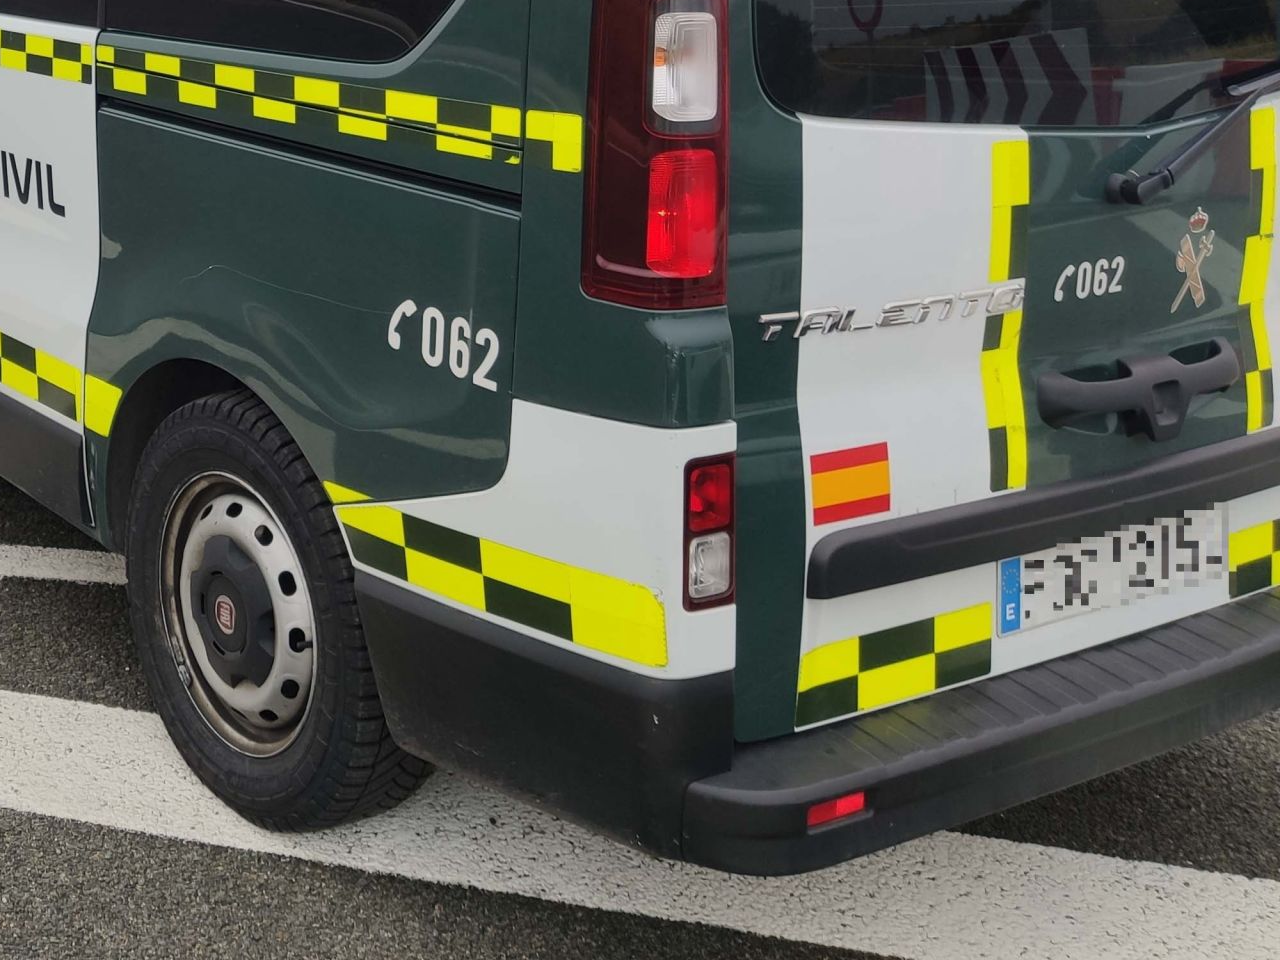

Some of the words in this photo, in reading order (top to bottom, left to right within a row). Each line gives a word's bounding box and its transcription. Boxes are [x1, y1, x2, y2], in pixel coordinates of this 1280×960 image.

[1076, 256, 1125, 299] 062
[758, 284, 1024, 341] TALENTO
[422, 307, 499, 392] 062
[1006, 603, 1015, 620] E
